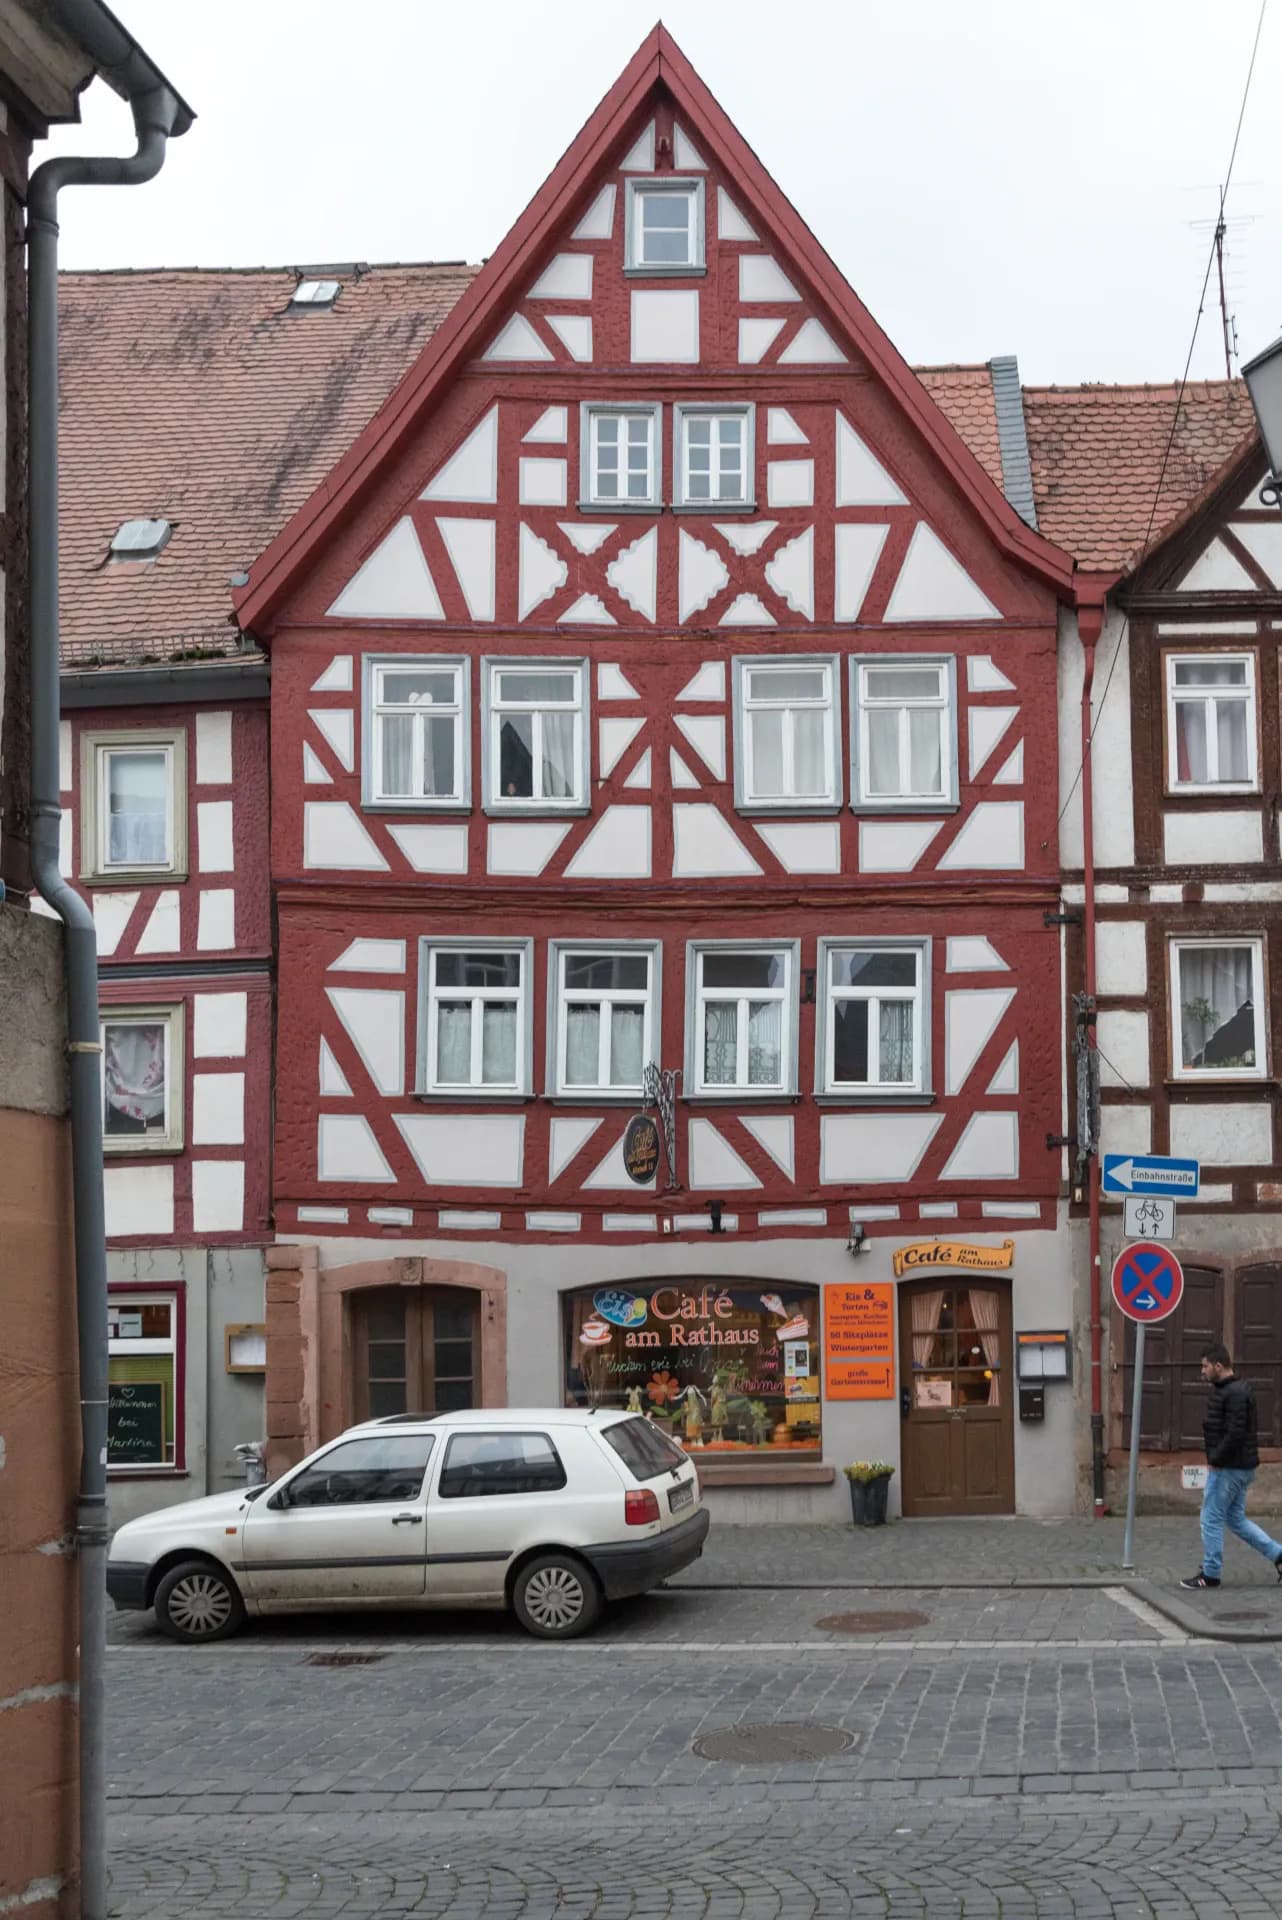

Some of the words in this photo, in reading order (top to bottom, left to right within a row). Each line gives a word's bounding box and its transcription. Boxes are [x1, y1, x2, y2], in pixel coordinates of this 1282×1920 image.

[1130, 1169, 1193, 1183] Einbahnstraße
[904, 1245, 952, 1264] Café
[959, 1248, 978, 1257] am
[957, 1255, 1004, 1266] Rathaus
[845, 1292, 861, 1301] Eis
[863, 1288, 874, 1301] &
[650, 1284, 734, 1321] Café
[841, 1303, 869, 1311] Torten
[625, 1330, 661, 1347] am
[669, 1321, 760, 1347] Rathaus
[830, 1343, 888, 1352] Wintergarten
[847, 1370, 869, 1378] große
[118, 1416, 138, 1427] bei
